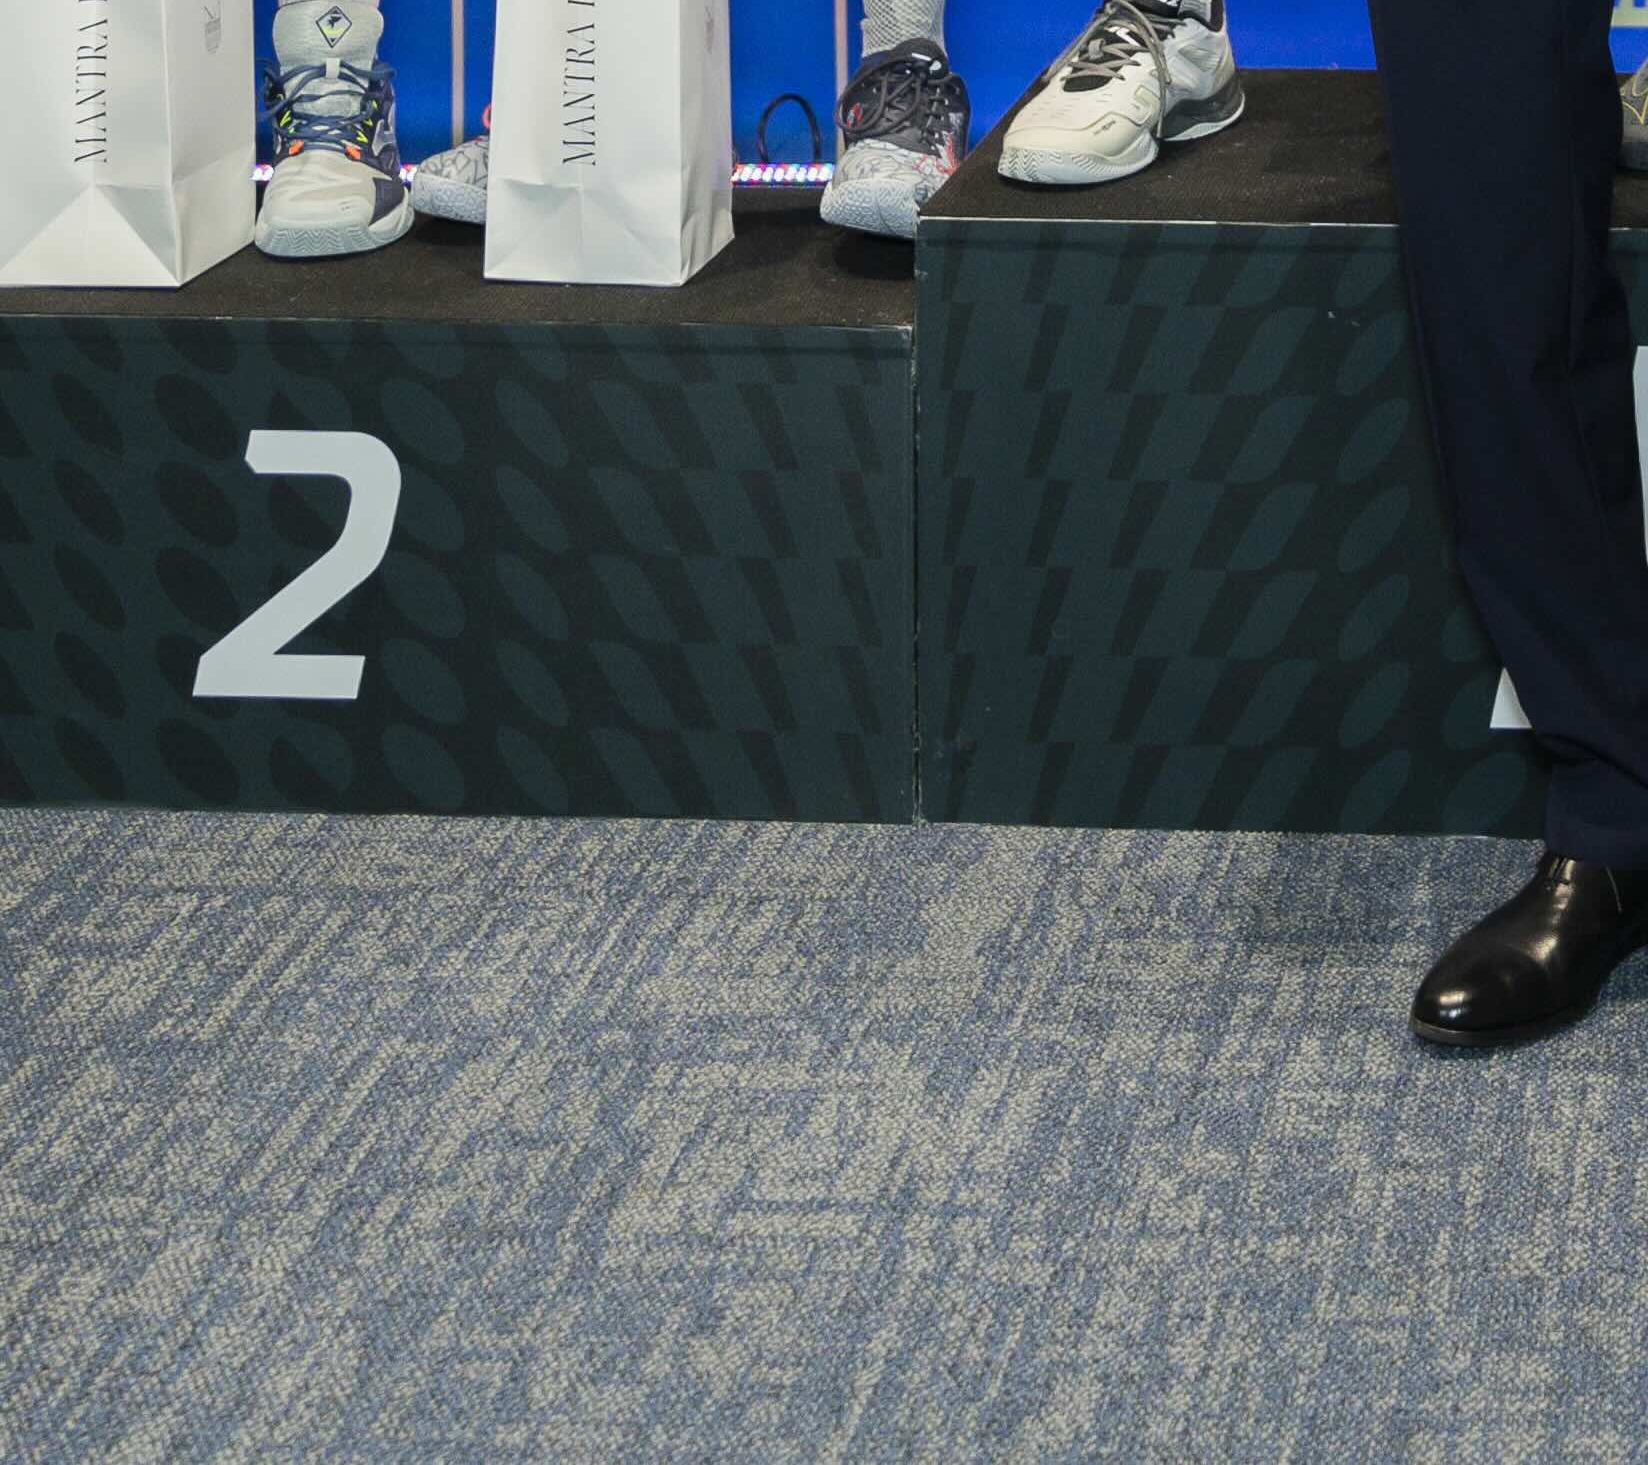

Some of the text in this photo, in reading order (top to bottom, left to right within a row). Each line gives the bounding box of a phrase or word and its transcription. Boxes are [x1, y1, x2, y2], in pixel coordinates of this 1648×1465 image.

[72, 16, 110, 165] MANTRA
[560, 35, 598, 168] MANTRA
[192, 428, 404, 700] 2
